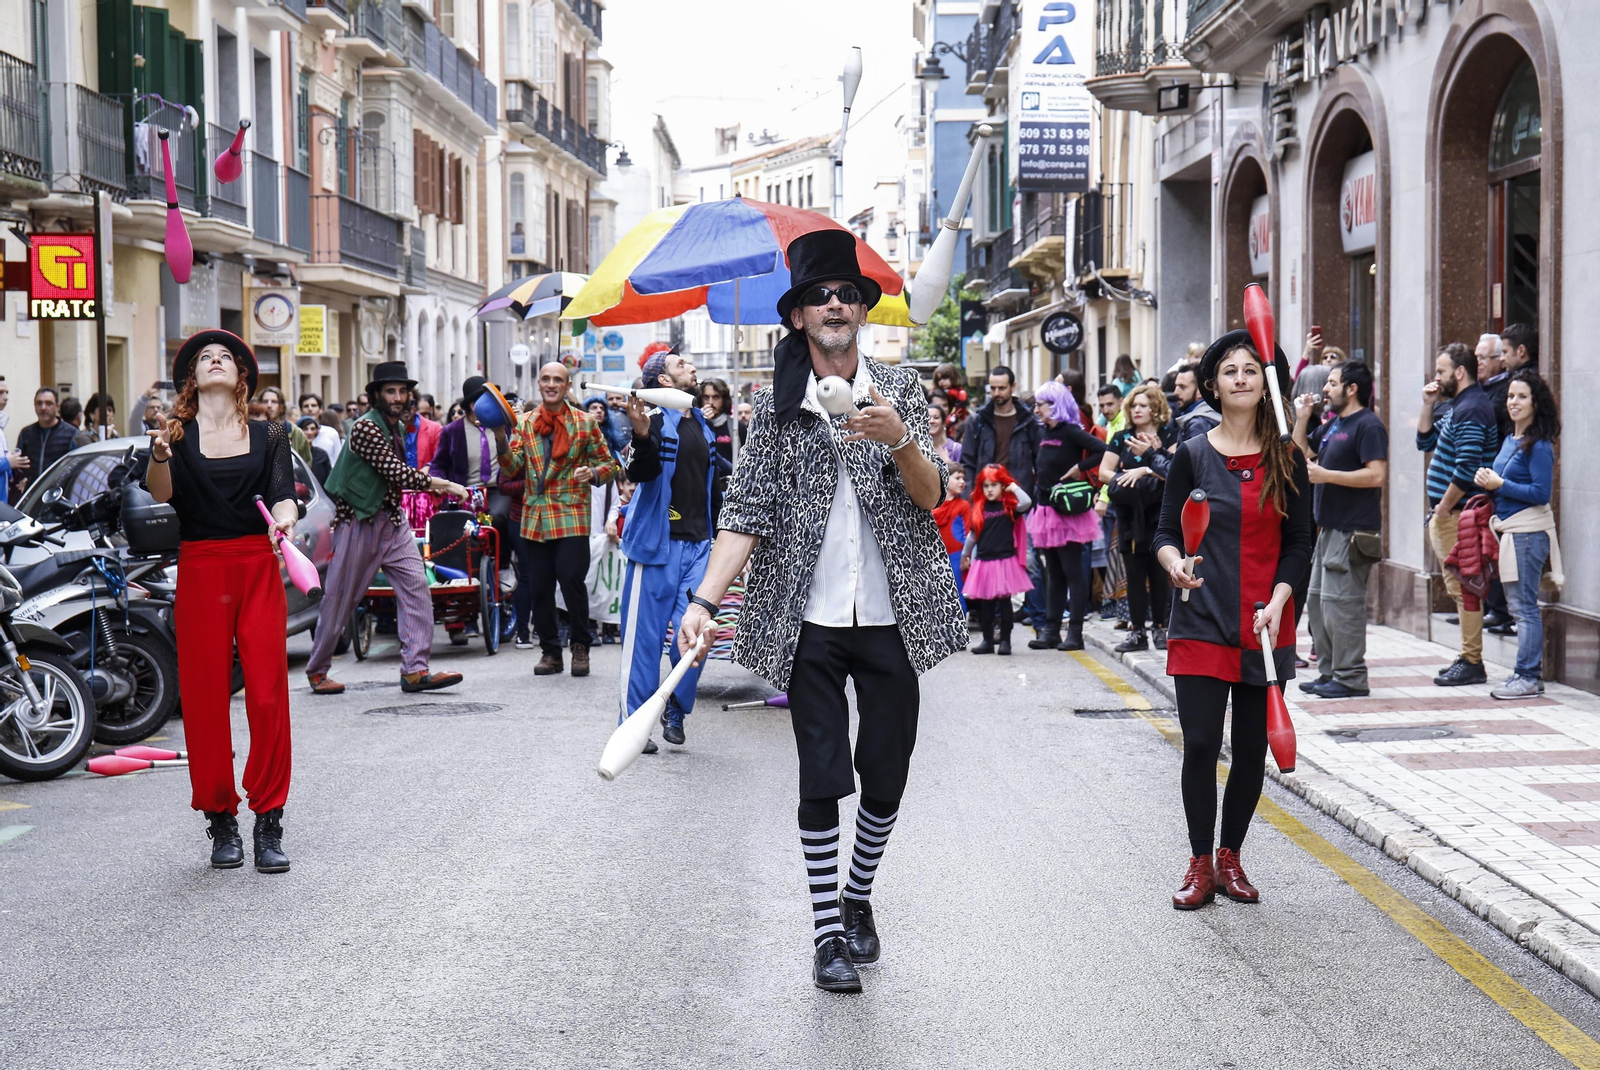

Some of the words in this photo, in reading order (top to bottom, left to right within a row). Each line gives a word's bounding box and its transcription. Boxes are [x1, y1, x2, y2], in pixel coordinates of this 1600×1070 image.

[1020, 127, 1040, 139] 609
[1042, 127, 1057, 139] 33
[1059, 128, 1074, 140] 83
[1075, 128, 1090, 140] 99
[1019, 144, 1040, 155] 678
[1042, 144, 1056, 155] 78
[1059, 144, 1073, 156] 55
[1075, 145, 1090, 156] 98
[1021, 159, 1087, 170] info@corepa.es
[1022, 172, 1085, 181] www.corepa.es
